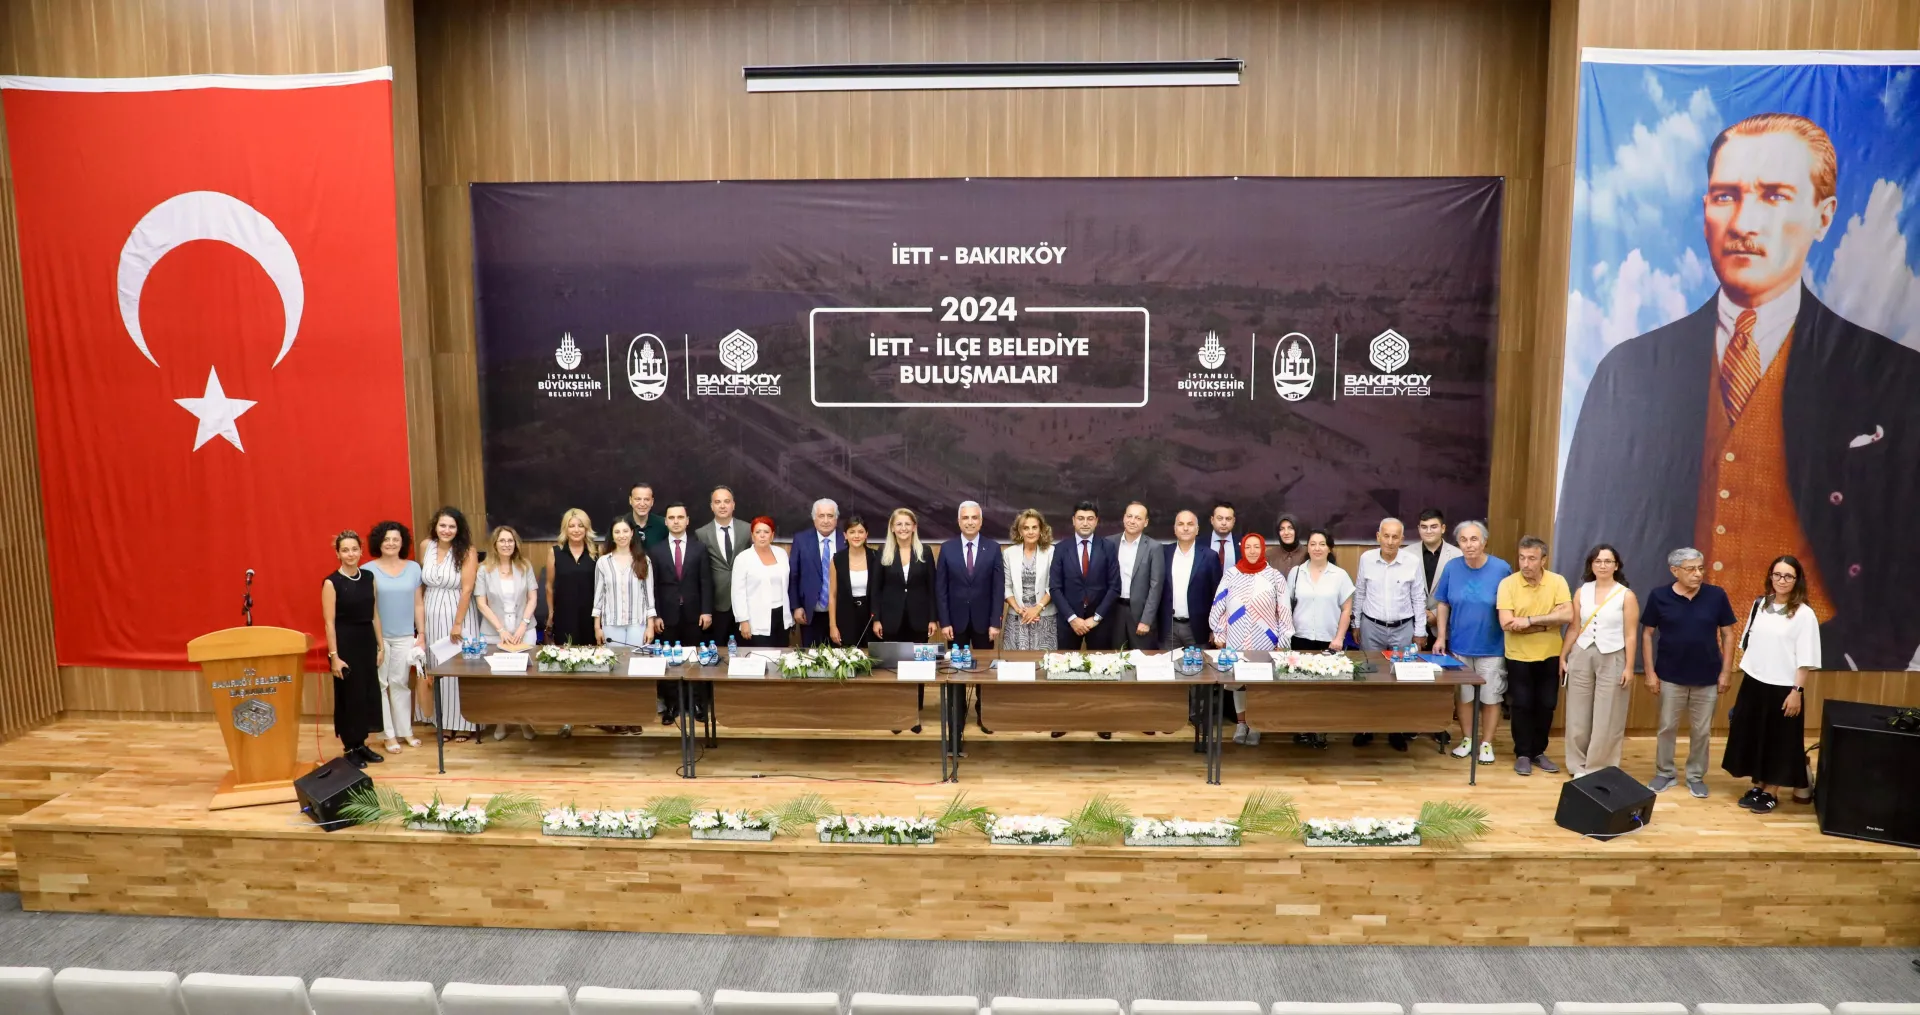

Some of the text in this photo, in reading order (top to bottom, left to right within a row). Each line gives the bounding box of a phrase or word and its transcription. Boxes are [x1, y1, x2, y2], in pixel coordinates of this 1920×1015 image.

[892, 241, 933, 265] İETT
[955, 241, 1067, 265] BAKIRKÖY
[940, 296, 1018, 322] 2024
[869, 332, 913, 356] İETT
[936, 332, 981, 361] İLÇE
[988, 332, 1090, 356] BELEDİYE
[547, 372, 591, 380] İSTANBUL
[696, 373, 781, 385] BAKIRKÖY
[900, 365, 1058, 389] BULUŞMALARI
[1344, 374, 1432, 386] BAKIRKÖY
[538, 380, 601, 390] BÜYÜKŞEHİR
[1177, 380, 1245, 390] BÜYÜKŞEHİR
